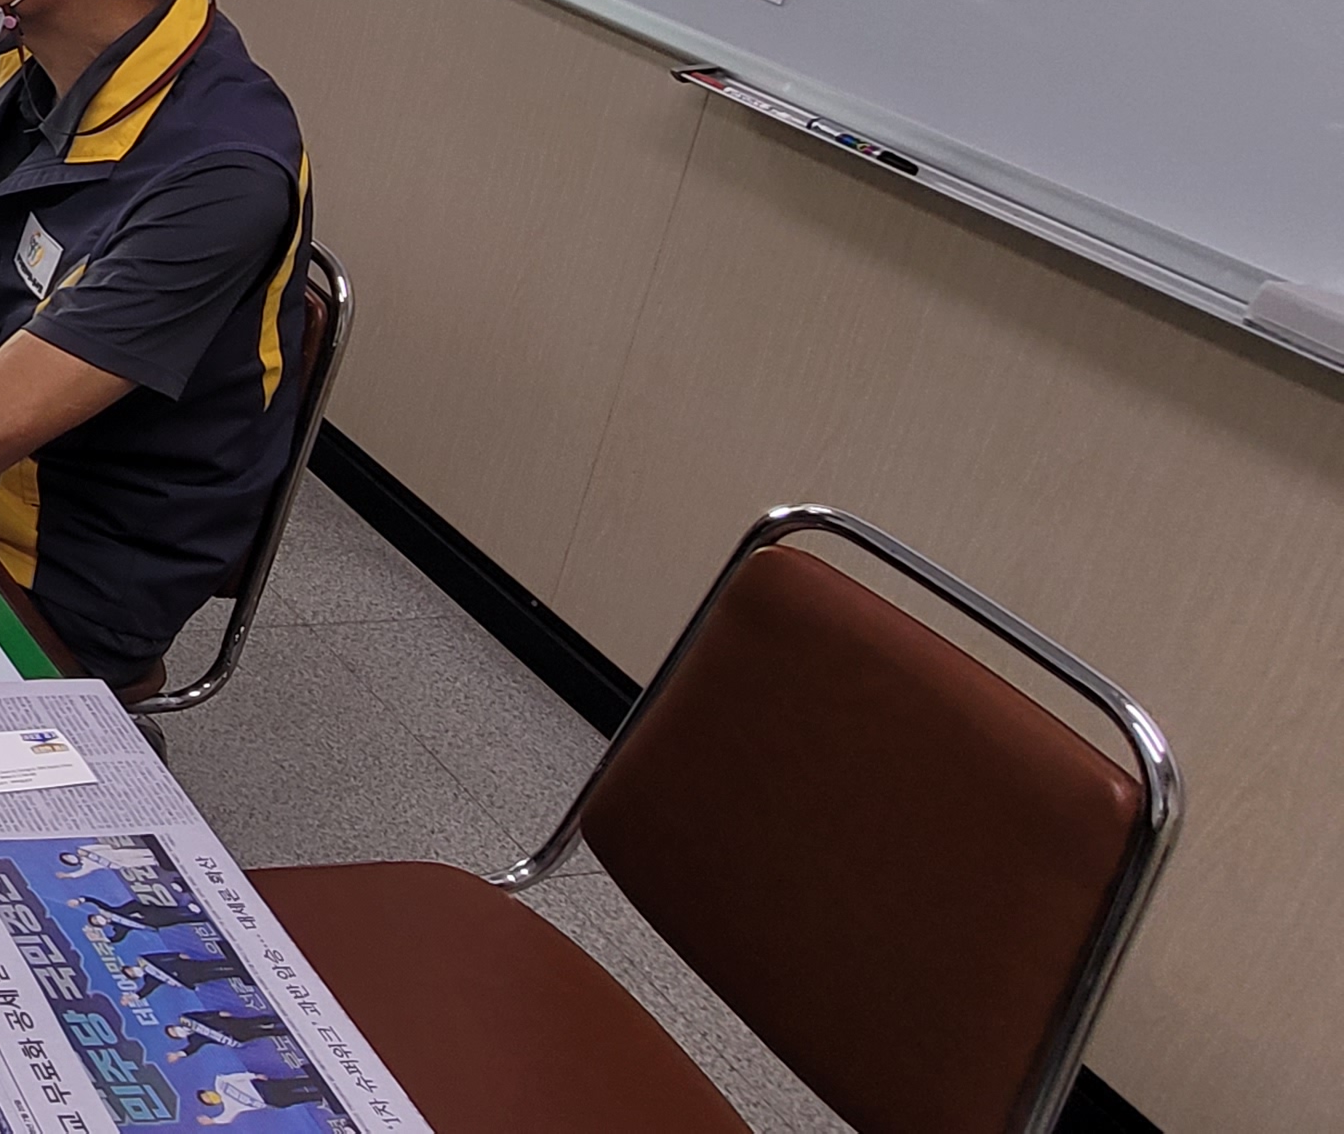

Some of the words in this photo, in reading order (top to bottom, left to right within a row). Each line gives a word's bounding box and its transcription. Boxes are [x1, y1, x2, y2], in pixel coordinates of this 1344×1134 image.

[195, 854, 224, 882] 확산
[218, 888, 258, 930] 대세론
[287, 984, 321, 1017] 과반
[20, 1037, 72, 1106] 무료화
